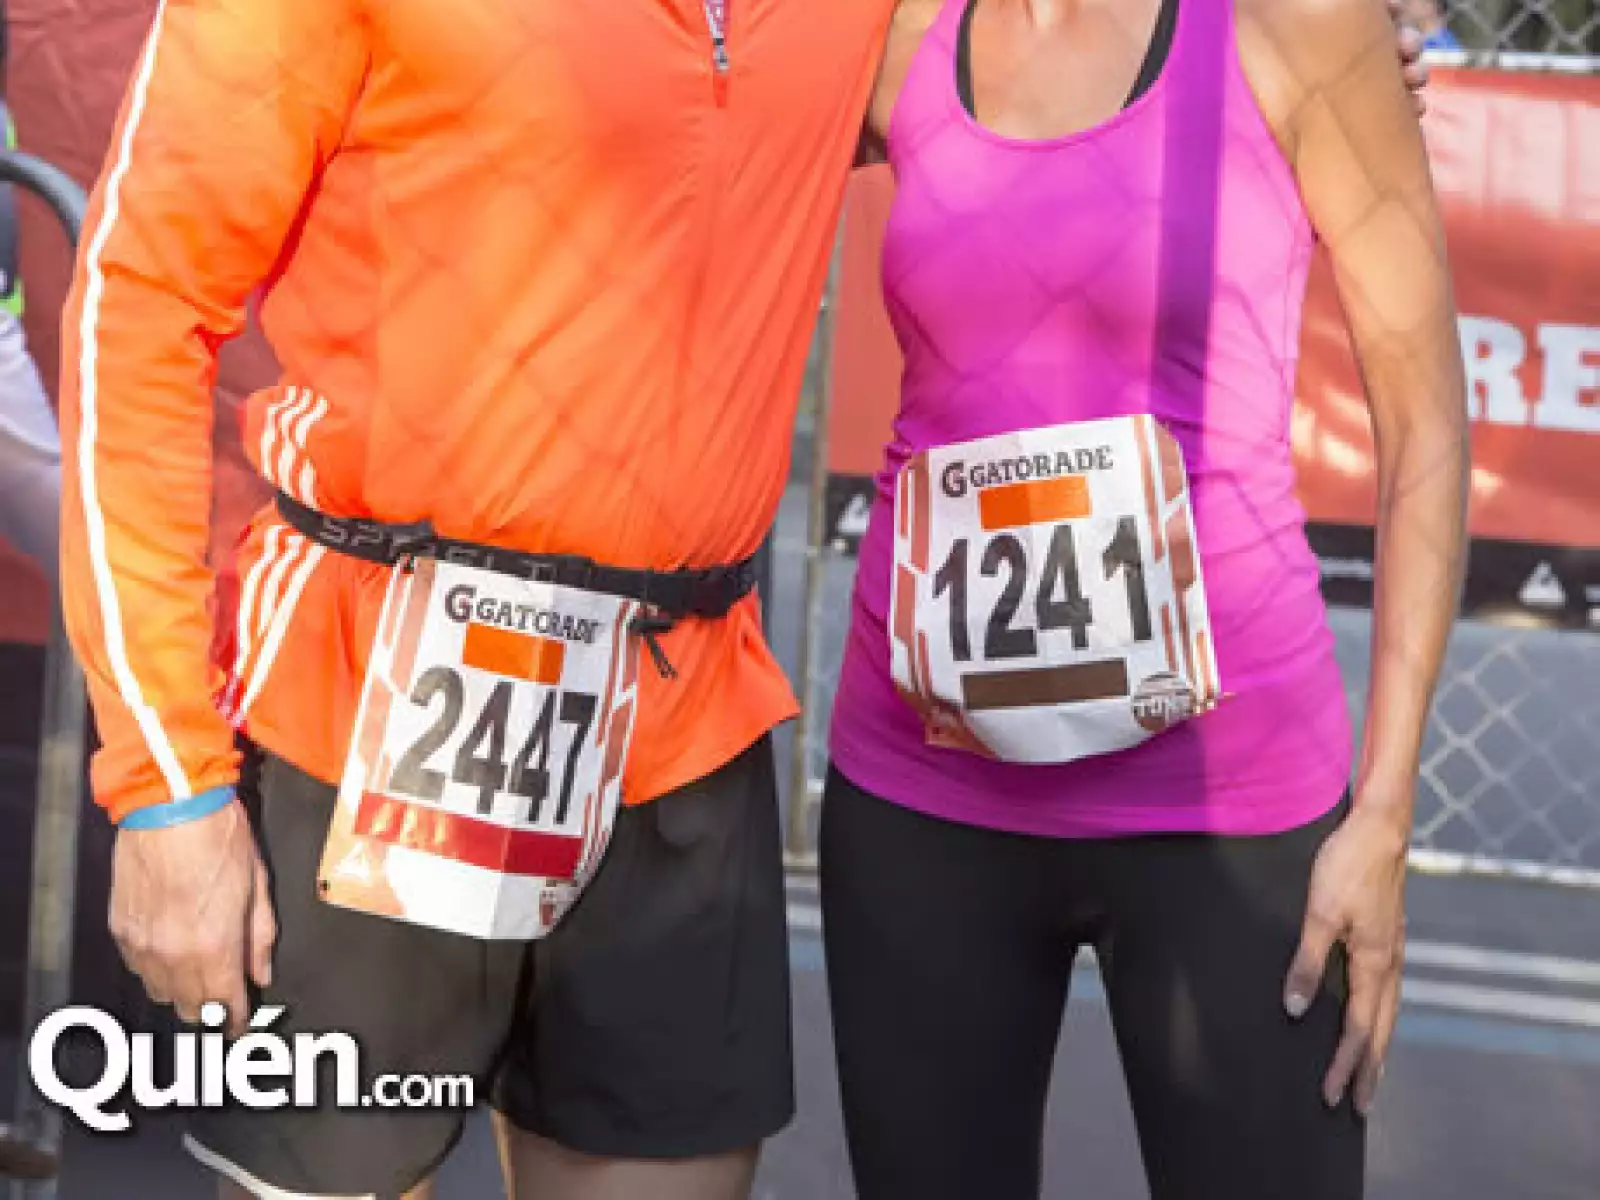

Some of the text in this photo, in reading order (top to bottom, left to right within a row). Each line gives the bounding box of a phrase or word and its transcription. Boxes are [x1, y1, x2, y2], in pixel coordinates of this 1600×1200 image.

[969, 445, 1114, 488] GATORADE
[931, 514, 1153, 661] 1241
[389, 666, 600, 825] 2447
